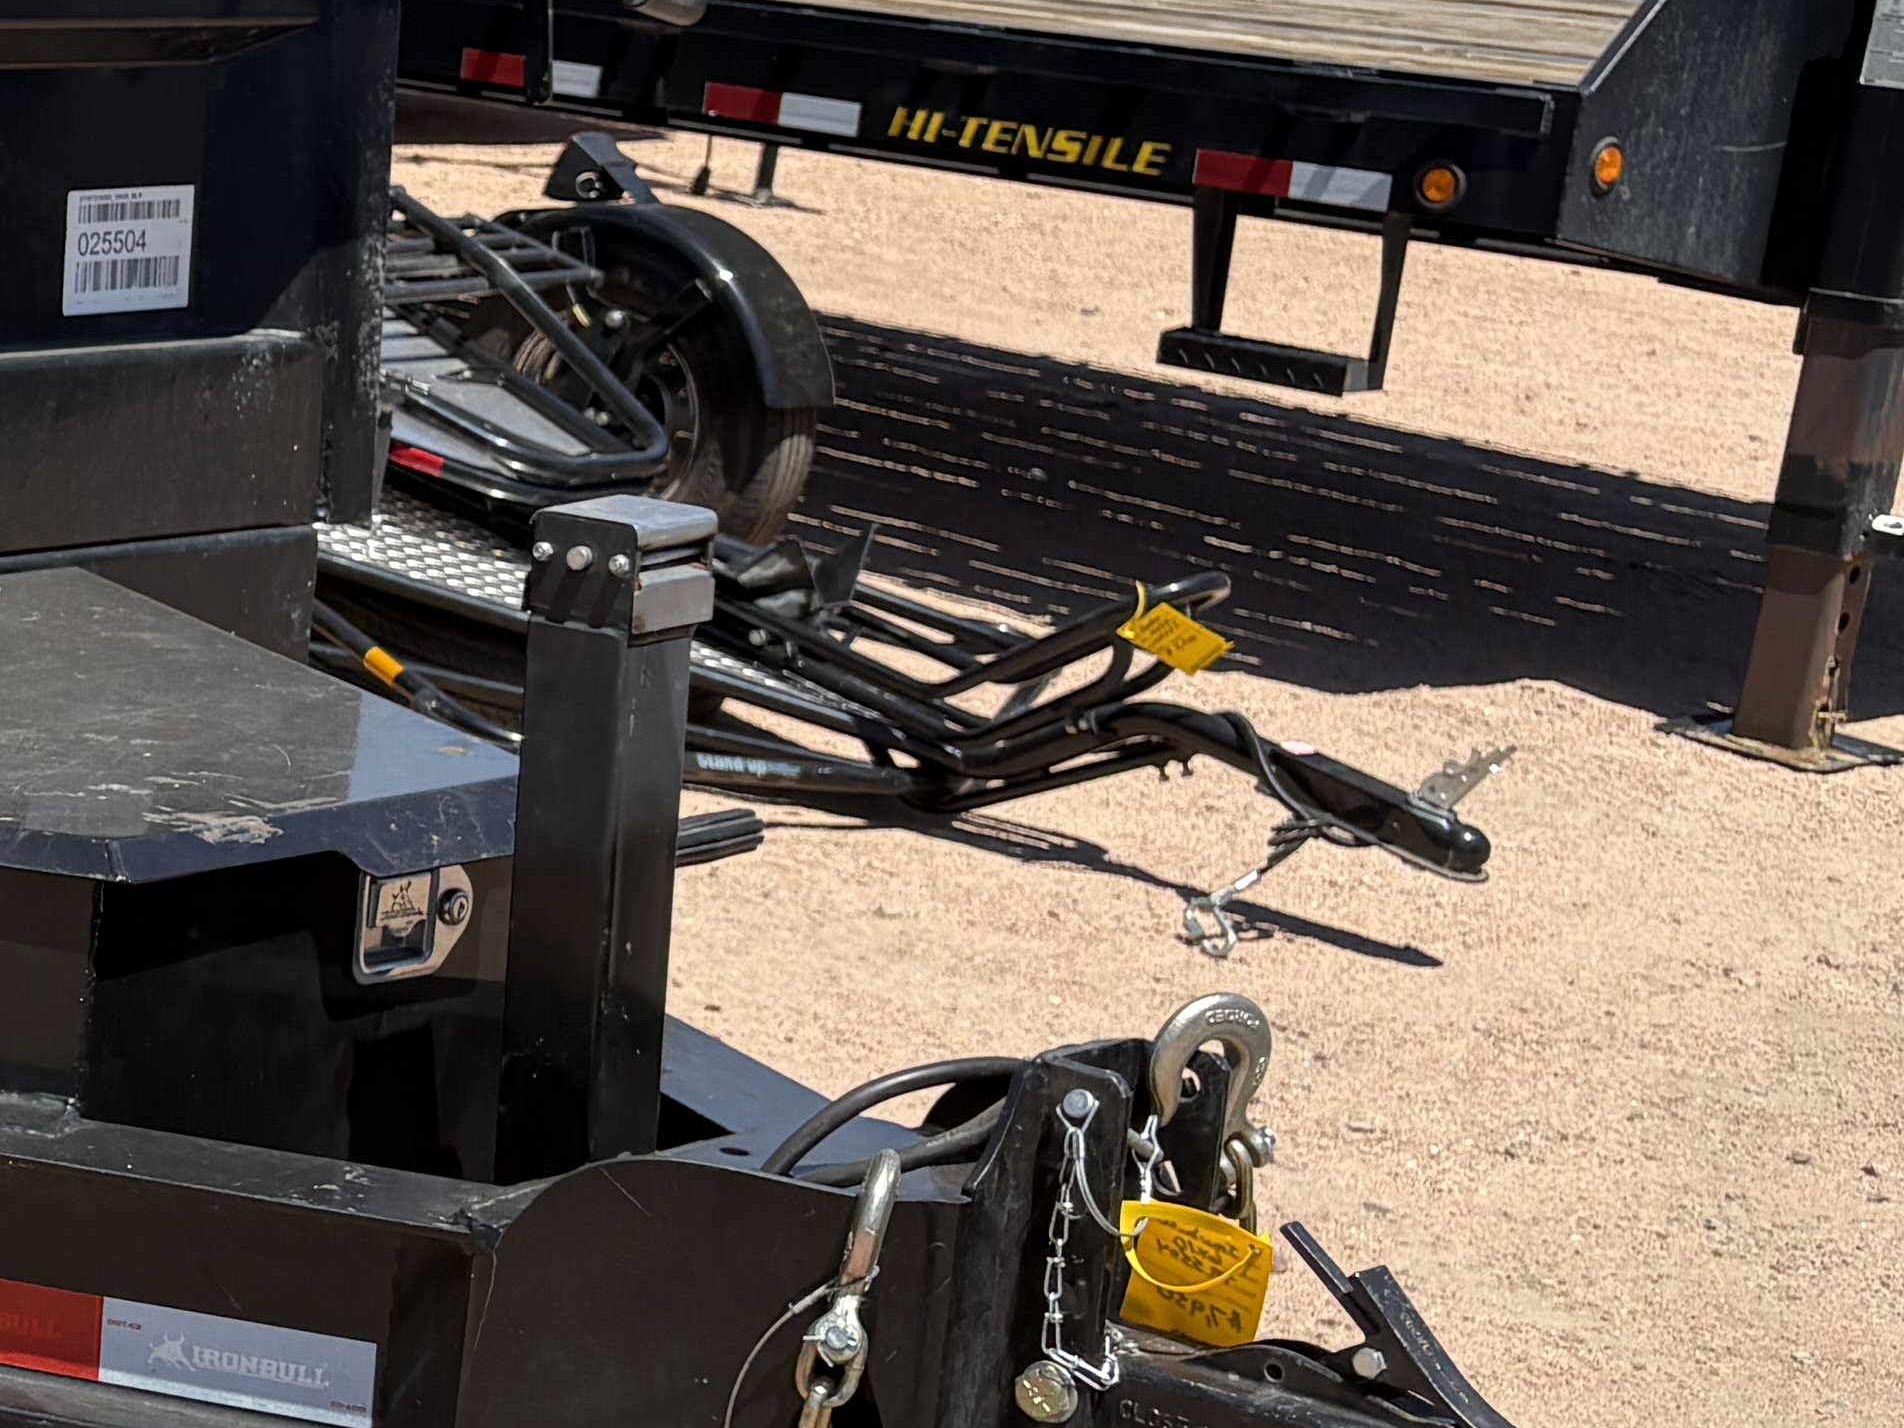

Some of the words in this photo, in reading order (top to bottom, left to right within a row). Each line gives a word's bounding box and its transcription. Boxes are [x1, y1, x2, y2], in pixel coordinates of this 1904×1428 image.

[887, 106, 1172, 176] HI-TENSILE
[78, 229, 147, 256] 025504
[191, 1345, 330, 1389] IRONBULL
